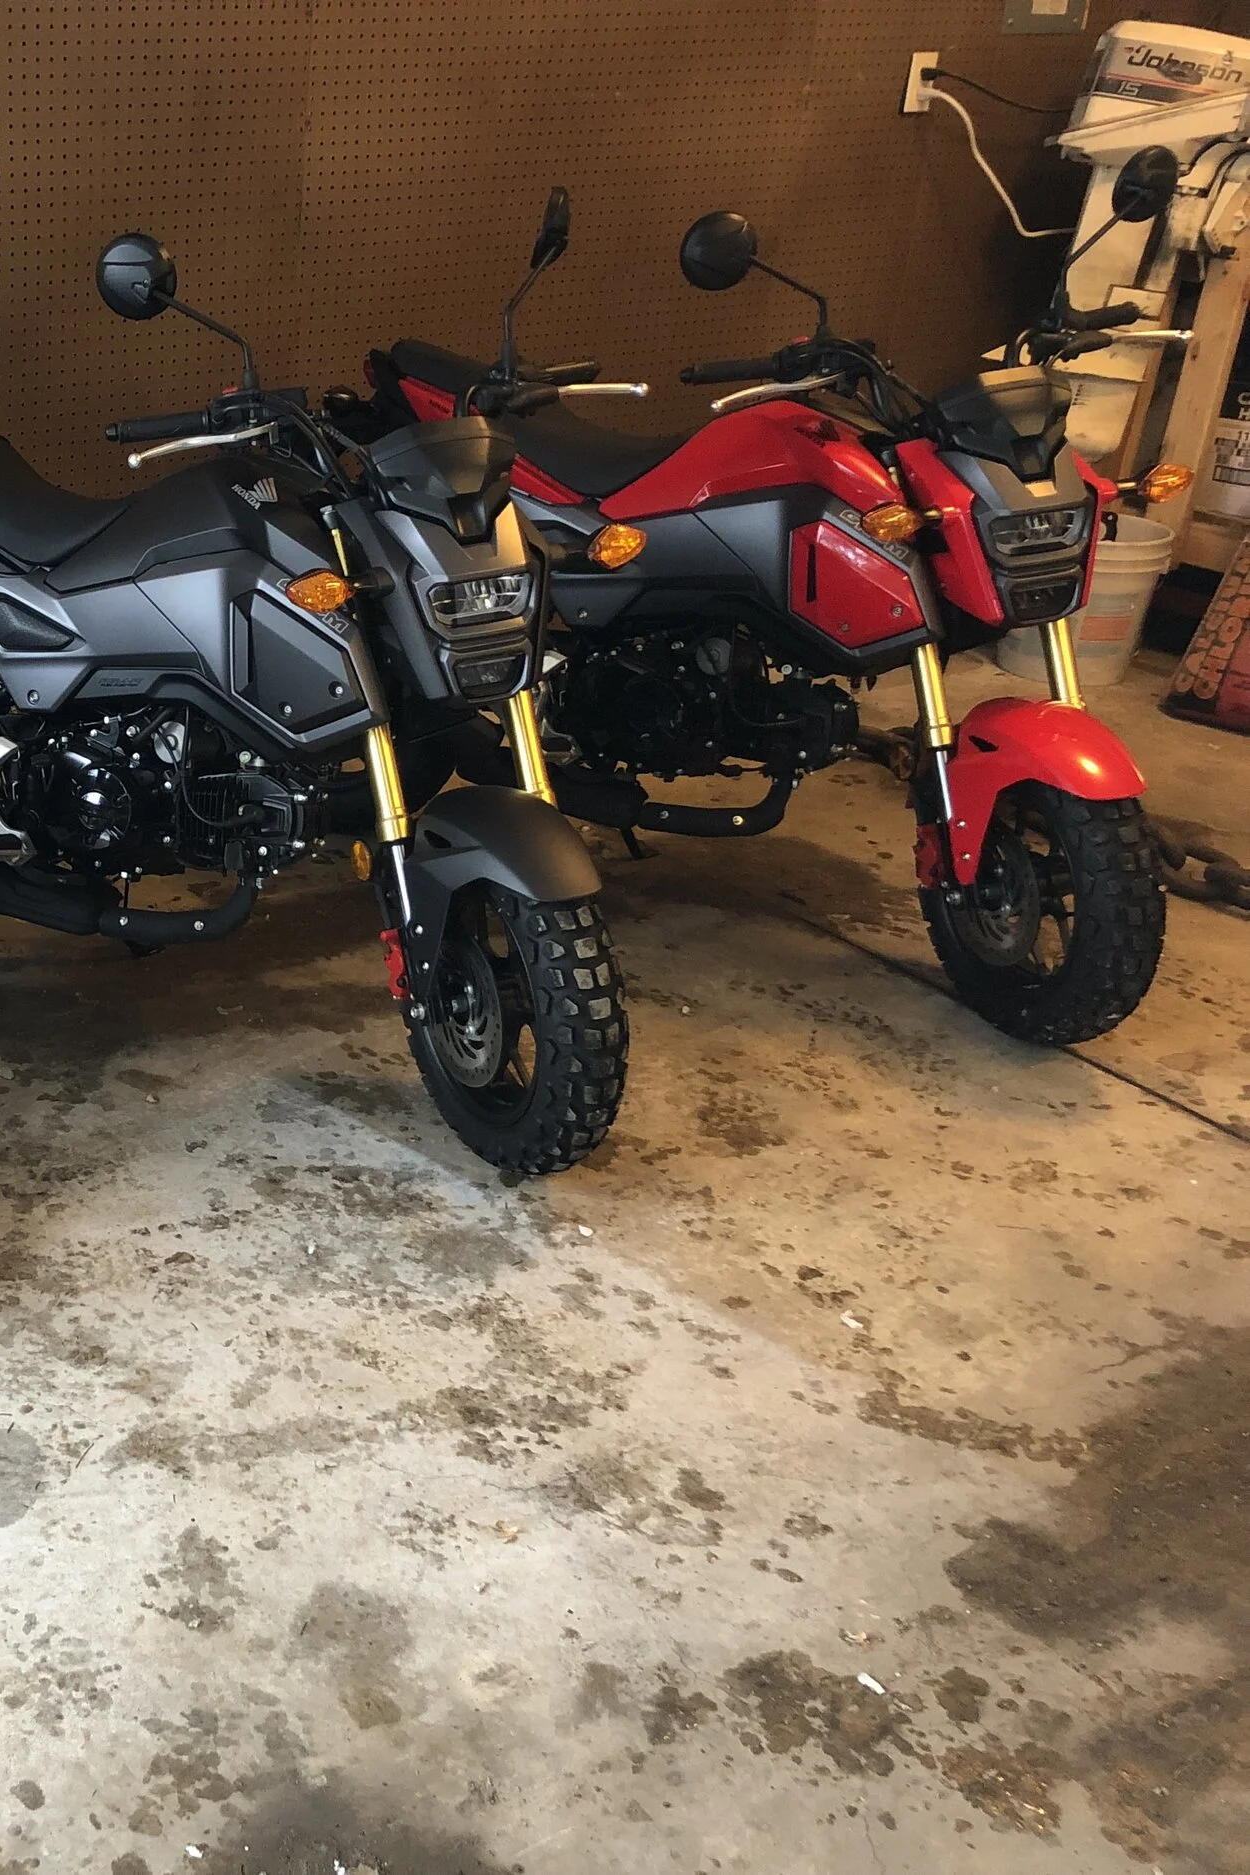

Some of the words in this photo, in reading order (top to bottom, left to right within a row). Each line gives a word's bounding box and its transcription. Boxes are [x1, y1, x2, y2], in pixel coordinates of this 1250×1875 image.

[1126, 45, 1242, 83] Johnson
[1117, 80, 1142, 96] 15
[231, 484, 261, 510] HONDA
[1192, 571, 1250, 699] CHLORI
